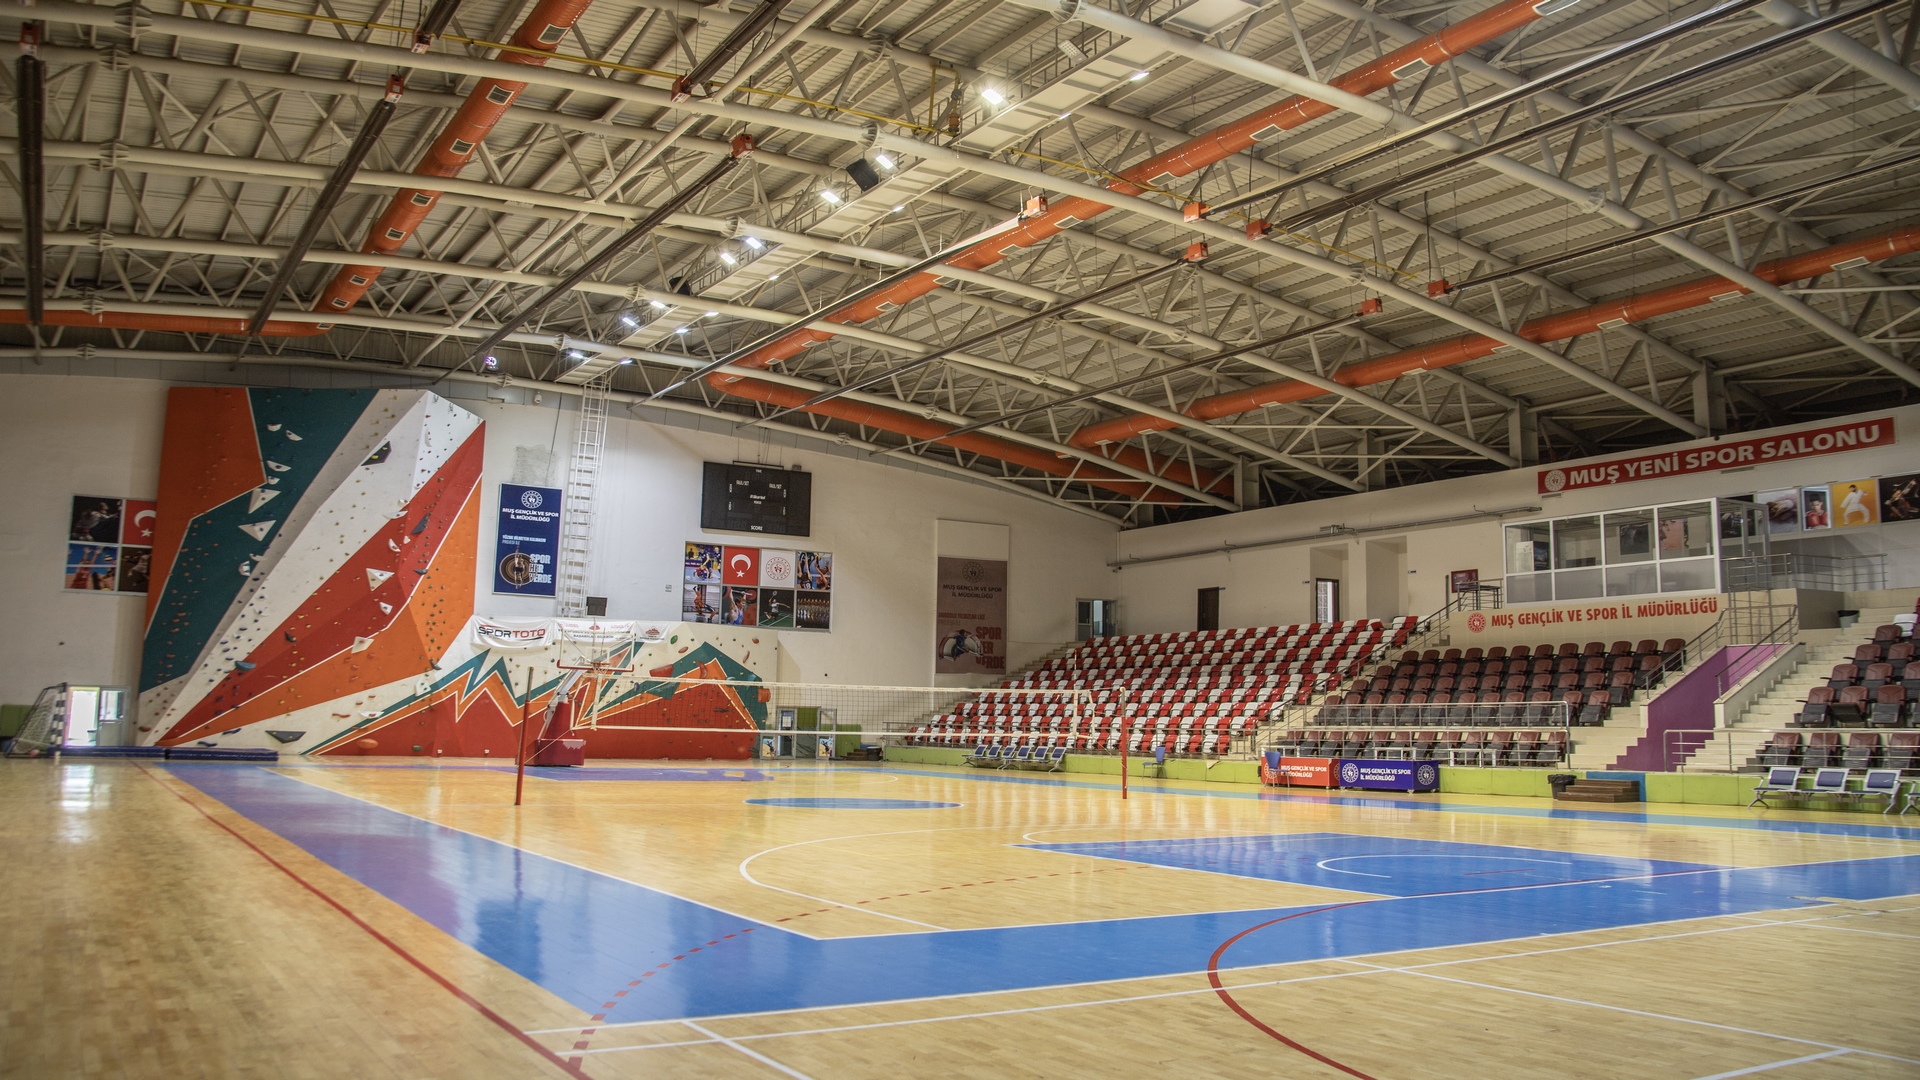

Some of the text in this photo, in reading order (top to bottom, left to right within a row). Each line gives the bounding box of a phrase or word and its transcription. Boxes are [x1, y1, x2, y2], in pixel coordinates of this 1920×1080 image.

[1569, 424, 1880, 484] MUŞ YENİ SPOR SALONU
[530, 554, 550, 564] SPOR
[1491, 598, 1718, 628] MUŞ GENÇLİK VE SPOR İL MÜDÜRLÜĞÜ
[975, 626, 1002, 640] SPOR
